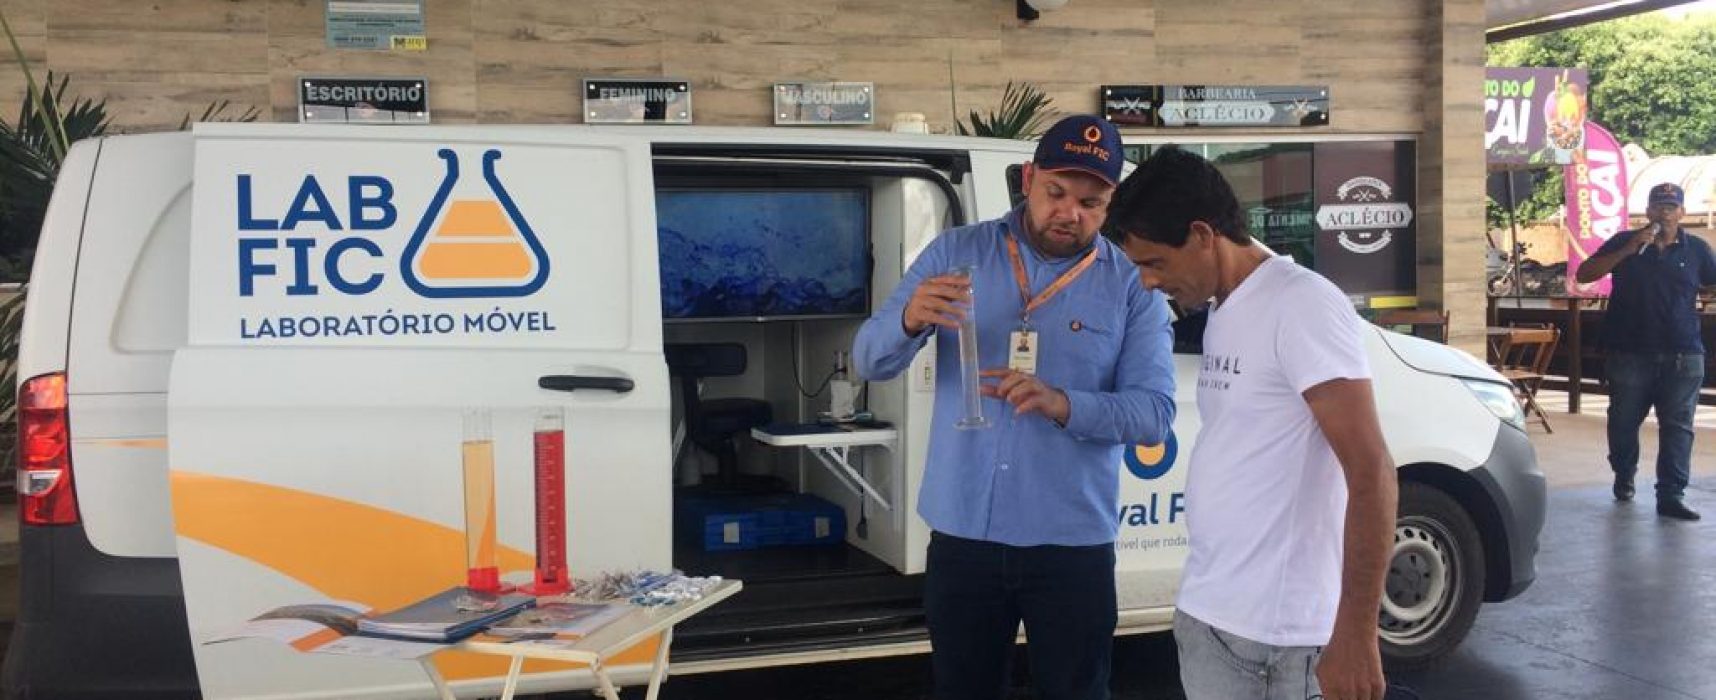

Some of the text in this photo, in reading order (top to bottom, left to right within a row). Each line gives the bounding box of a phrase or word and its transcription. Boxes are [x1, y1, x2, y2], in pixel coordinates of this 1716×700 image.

[307, 82, 420, 102] ESCRITÓRIO
[600, 88, 677, 105] FEMININO
[1179, 86, 1257, 100] BARBEARIA
[1502, 79, 1519, 97] DO
[1171, 103, 1265, 121] ACLÉCIO
[237, 173, 398, 231] LAB
[1327, 206, 1404, 227] ACLÉCIO
[237, 237, 385, 297] FIC
[240, 306, 556, 339] LABORATÓRIO MÓVEL
